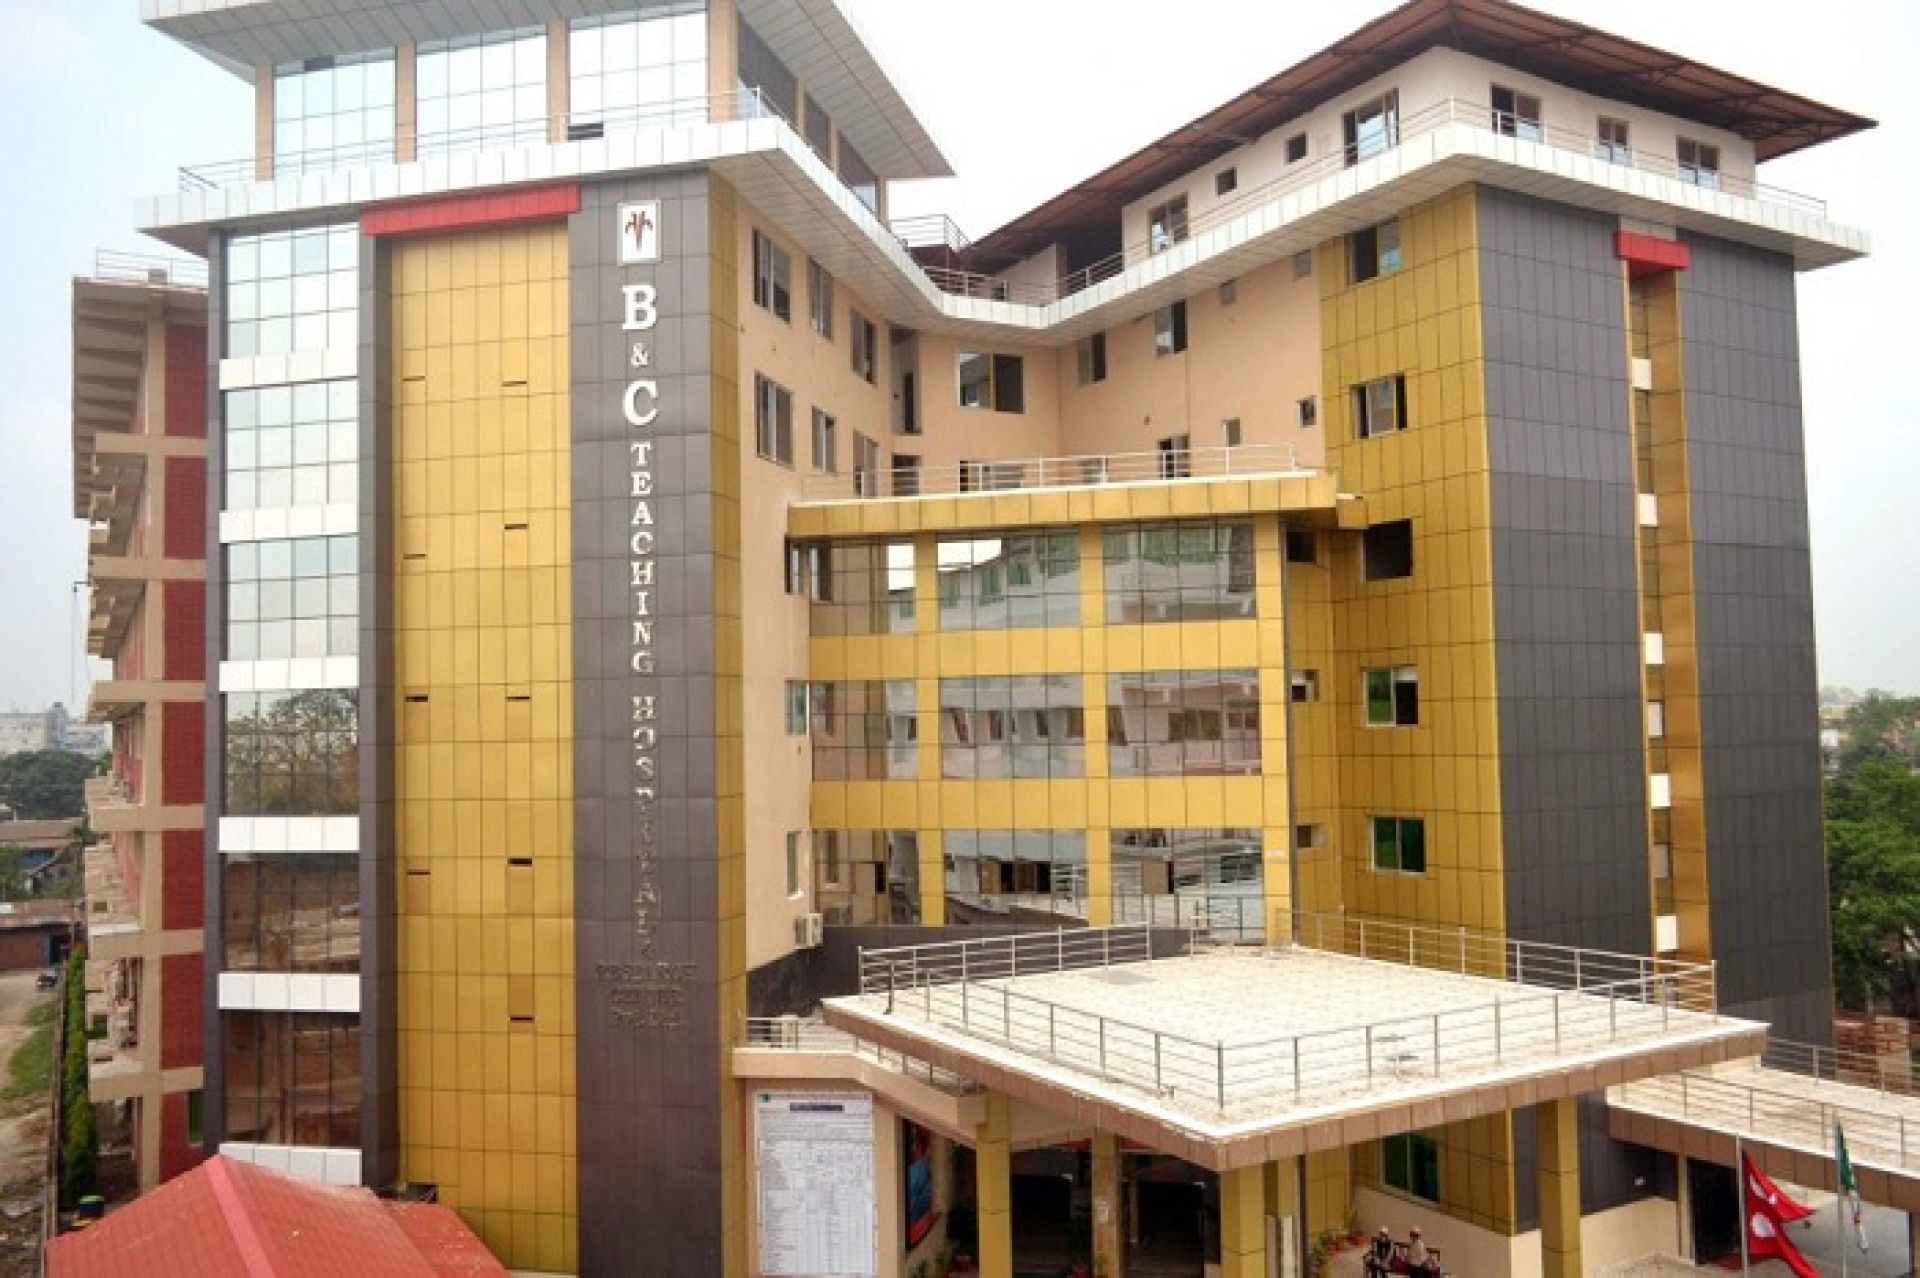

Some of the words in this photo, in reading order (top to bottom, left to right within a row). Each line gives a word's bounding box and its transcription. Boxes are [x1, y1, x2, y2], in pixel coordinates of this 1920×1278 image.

[622, 284, 658, 330] B
[630, 342, 650, 368] &
[624, 380, 659, 426] C
[630, 441, 655, 674] TEACHING
